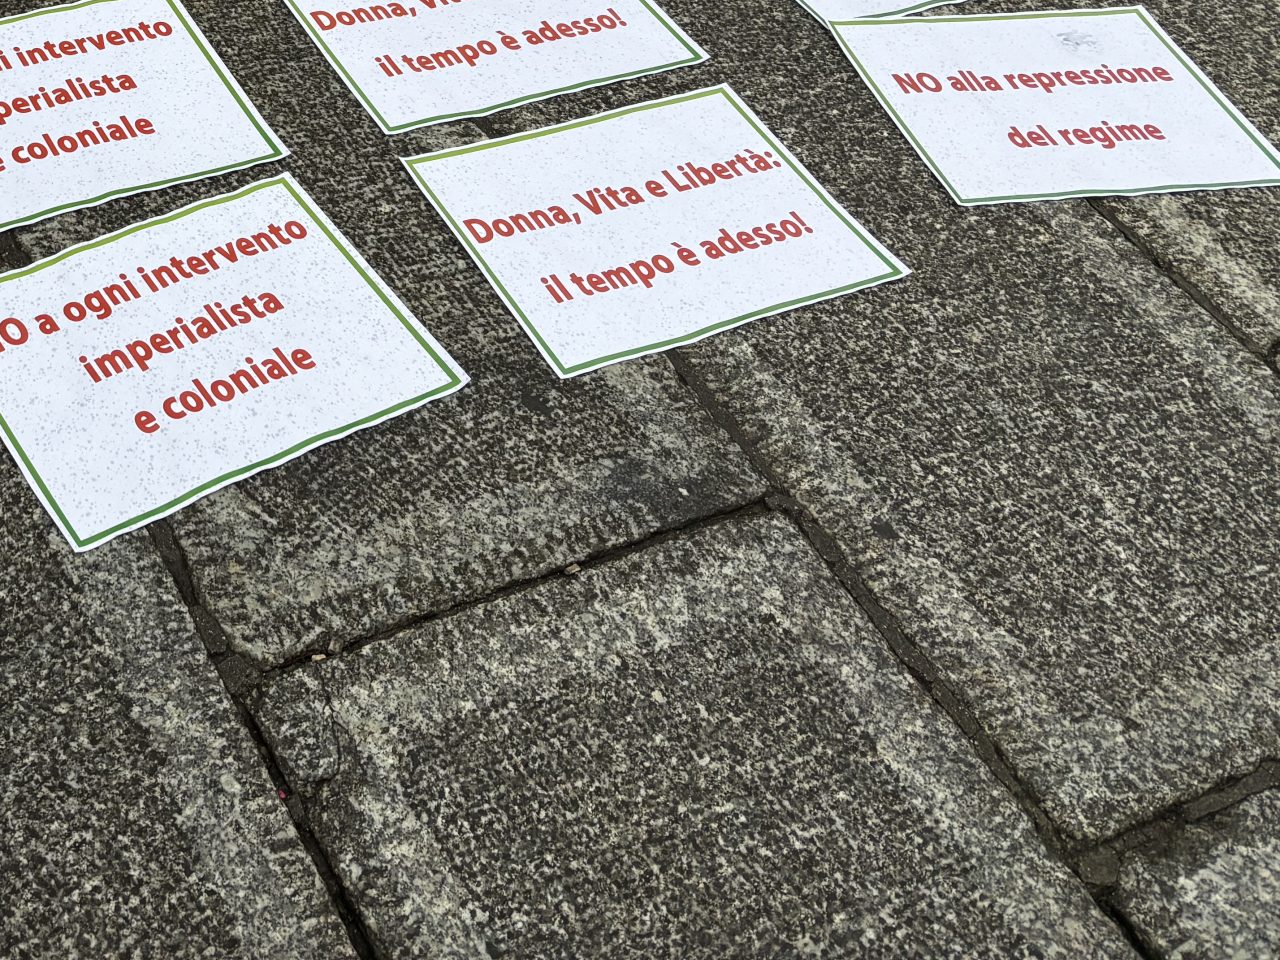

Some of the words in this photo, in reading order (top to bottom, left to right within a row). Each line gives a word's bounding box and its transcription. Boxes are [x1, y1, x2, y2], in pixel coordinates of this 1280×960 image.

[12, 20, 173, 68] intervento
[309, 1, 417, 32] Donna,
[374, 54, 403, 78] il
[401, 39, 498, 73] tempo
[497, 31, 521, 51] è
[522, 7, 626, 46] adesso!
[892, 72, 943, 95] NO
[947, 70, 1003, 92] alla
[1004, 66, 1172, 94] repressione
[11, 115, 157, 165] coloniale
[1007, 125, 1057, 149] del
[1058, 121, 1165, 150] regime
[463, 205, 581, 245] Donna,
[576, 186, 645, 219] Vita
[644, 179, 669, 198] e
[662, 150, 782, 193] Libertà:
[33, 313, 61, 336] a
[63, 273, 141, 323] ogni
[136, 220, 308, 294] intervento
[541, 274, 574, 304] il
[569, 254, 676, 297] tempo
[672, 242, 701, 267] è
[700, 211, 813, 260] adesso!
[79, 292, 284, 384] imperialista
[133, 410, 161, 435] e
[162, 347, 317, 421] coloniale
